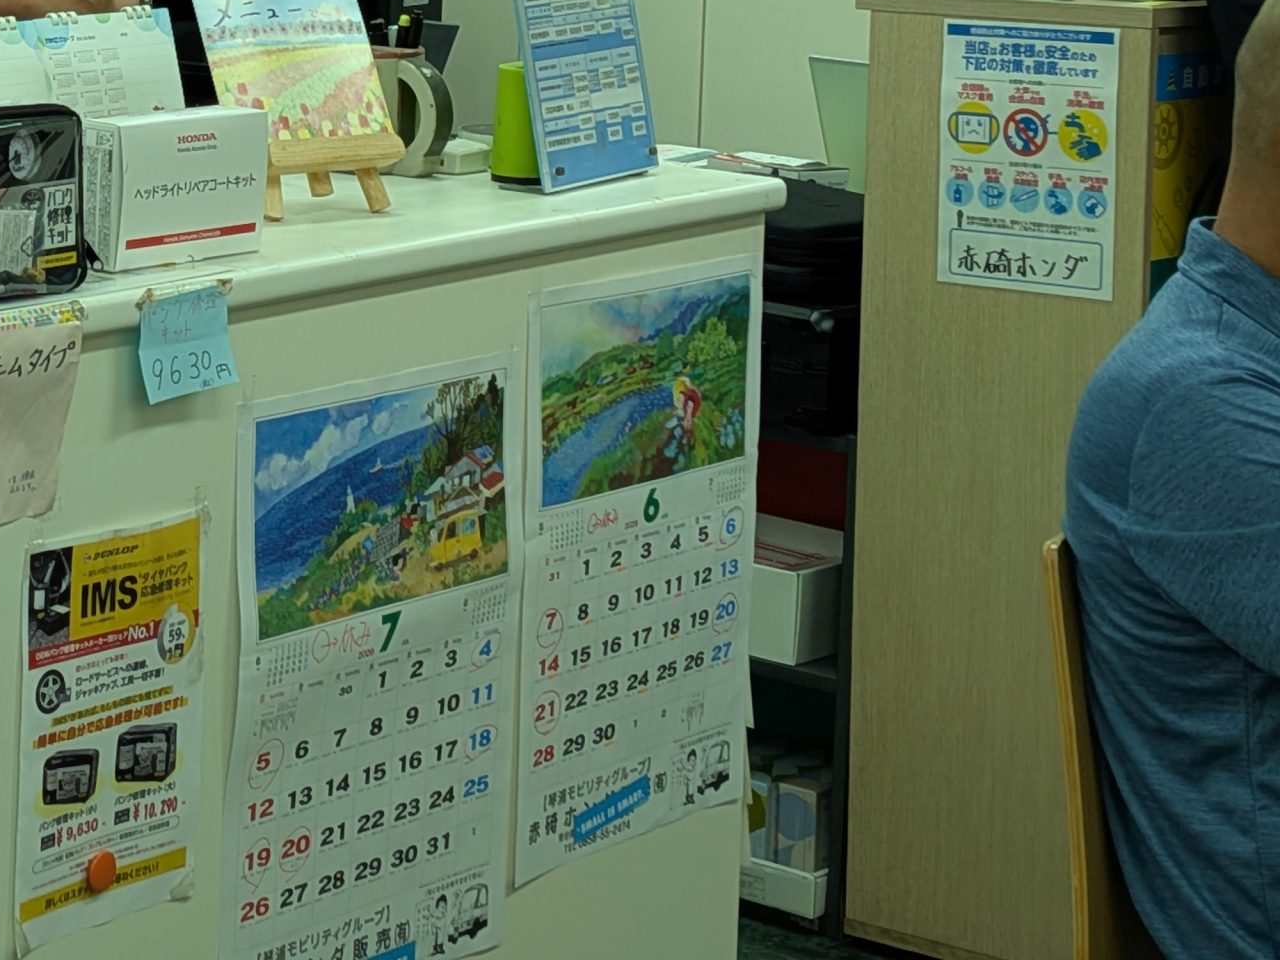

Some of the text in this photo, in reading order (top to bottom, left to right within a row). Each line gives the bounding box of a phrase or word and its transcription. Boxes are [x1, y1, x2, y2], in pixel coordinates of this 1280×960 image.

[962, 56, 1098, 78] 下記の対策を徹底しています
[964, 41, 1096, 62] 当店はお客様の安全のため
[177, 133, 217, 144] HONDA
[47, 188, 72, 206] パンク
[134, 173, 256, 200] ヘッドライトリペアコートキット
[48, 206, 72, 226] 修理
[48, 226, 72, 244] キット
[958, 245, 1088, 280] 赤碕ホンダ
[643, 488, 660, 523] 6
[583, 525, 709, 575] 1 2 4 5
[81, 575, 138, 619] IMS
[379, 610, 402, 653] 7
[378, 650, 457, 688] 1 3
[565, 670, 649, 712] 22 24
[533, 724, 615, 767] 28 30
[287, 740, 458, 809] 13 15 17
[355, 833, 450, 881] 29 31
